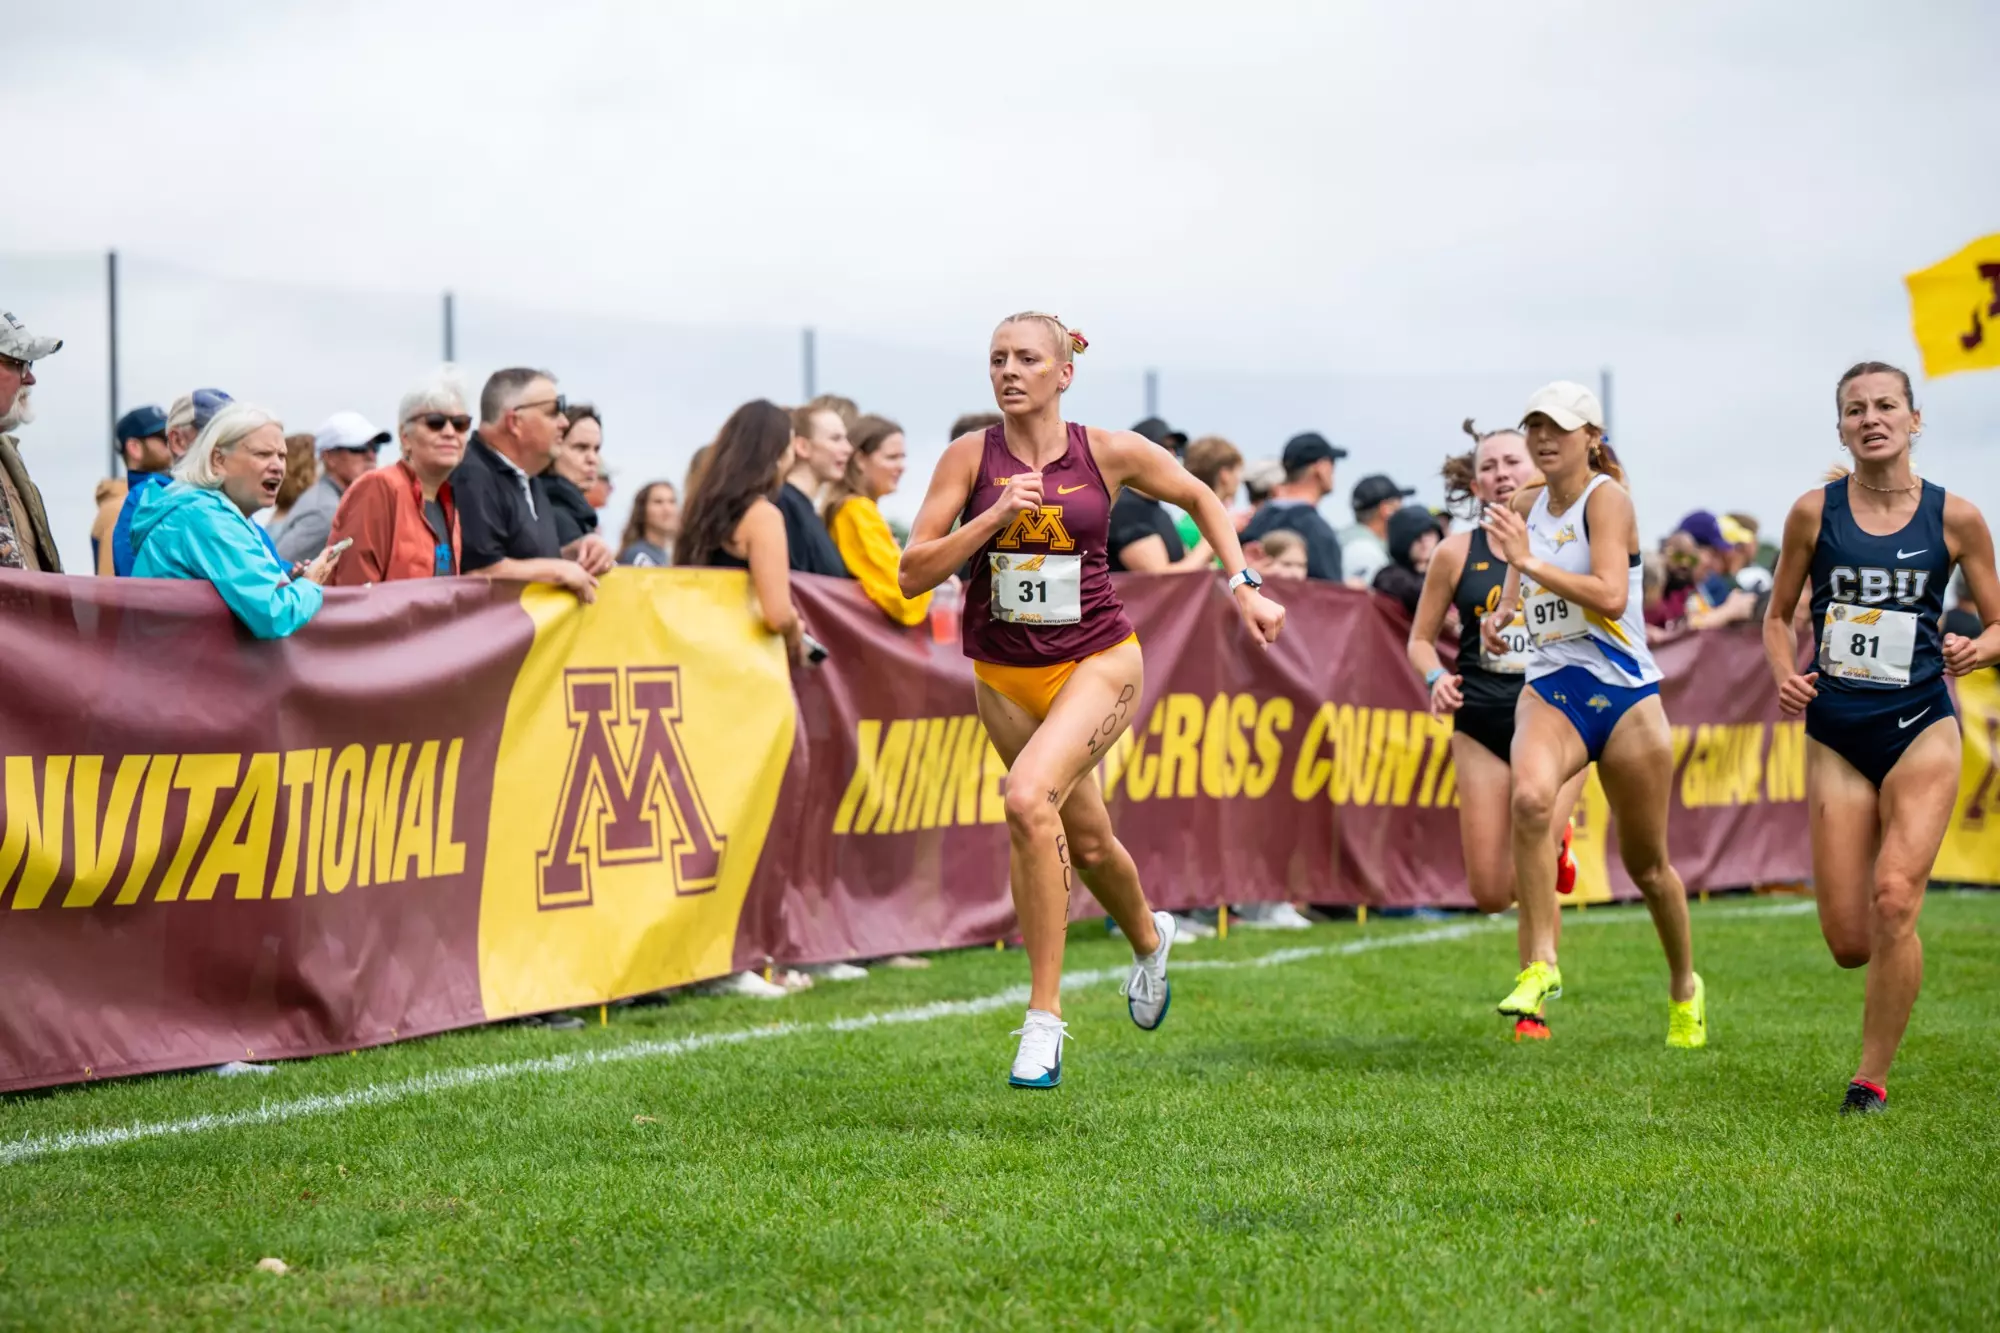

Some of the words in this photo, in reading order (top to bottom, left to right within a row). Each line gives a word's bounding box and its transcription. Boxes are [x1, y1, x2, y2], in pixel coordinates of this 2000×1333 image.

[996, 505, 1075, 550] M
[1018, 580, 1047, 603] 31
[1830, 566, 1930, 605] CBU
[1534, 599, 1569, 625] 979
[1850, 633, 1880, 659] 81
[1291, 701, 1461, 809] COUNT
[536, 664, 728, 912] M
